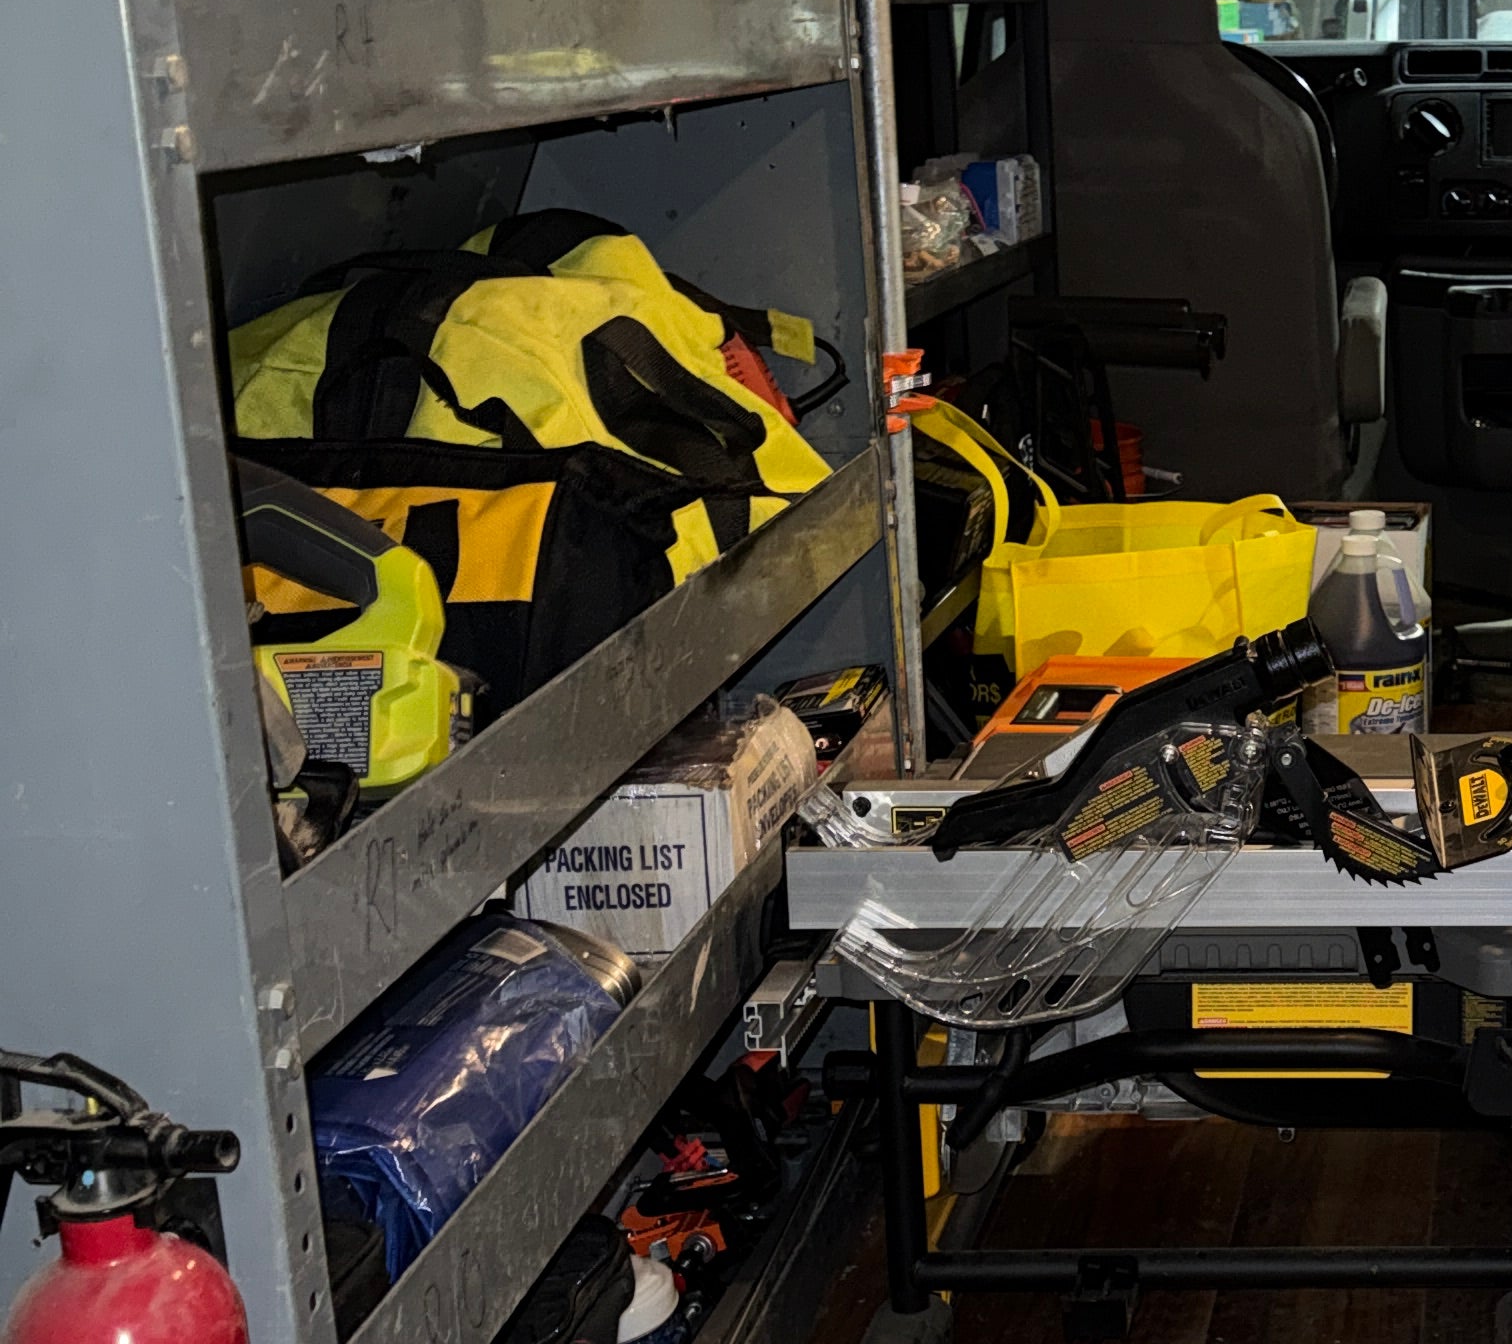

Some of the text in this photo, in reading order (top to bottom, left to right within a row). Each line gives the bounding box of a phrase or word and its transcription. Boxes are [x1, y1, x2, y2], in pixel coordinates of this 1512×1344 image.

[545, 844, 686, 874] PACKING LIST
[564, 883, 672, 911] ENCLOSED
